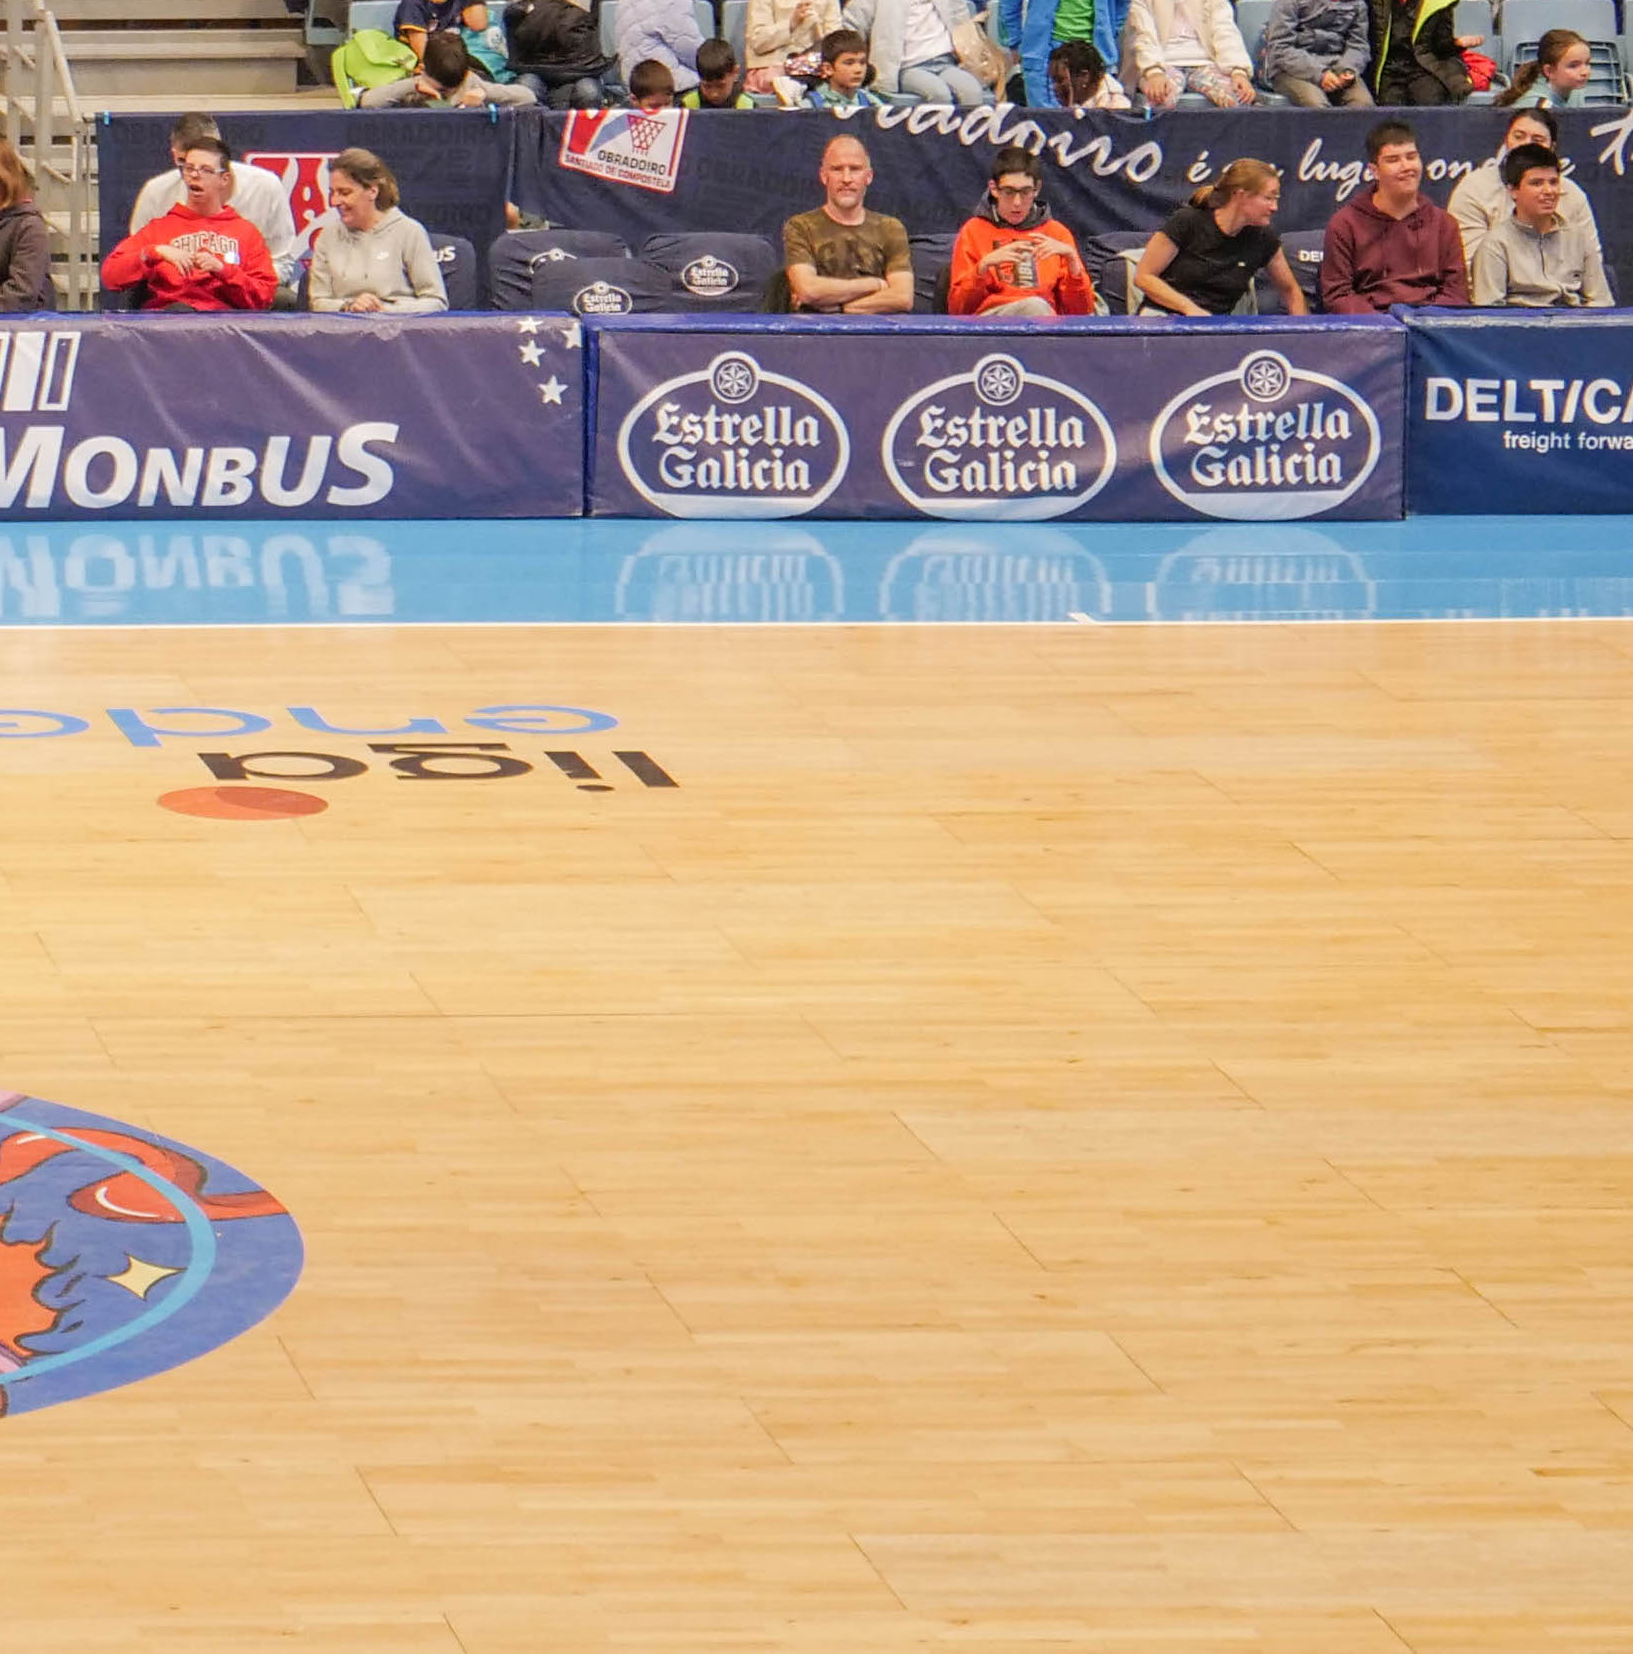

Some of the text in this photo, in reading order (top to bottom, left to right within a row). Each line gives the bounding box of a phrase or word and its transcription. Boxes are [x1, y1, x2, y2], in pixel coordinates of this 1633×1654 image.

[564, 153, 672, 189] SANTIAGO DE COMPOSTELA
[597, 149, 667, 176] OBRADOIRO
[173, 232, 238, 256] CHICAGO
[691, 266, 730, 278] Estrella
[693, 276, 729, 287] Galicia
[583, 293, 622, 305] Estrella
[652, 403, 821, 447] Estrella
[916, 406, 1086, 449] Estrella
[1183, 402, 1353, 446] Estrella
[1503, 429, 1633, 454] freight forwa
[659, 447, 812, 492] Galicia
[924, 449, 1078, 494] Galicia
[1190, 442, 1343, 488] Galicia
[197, 740, 681, 794] liga
